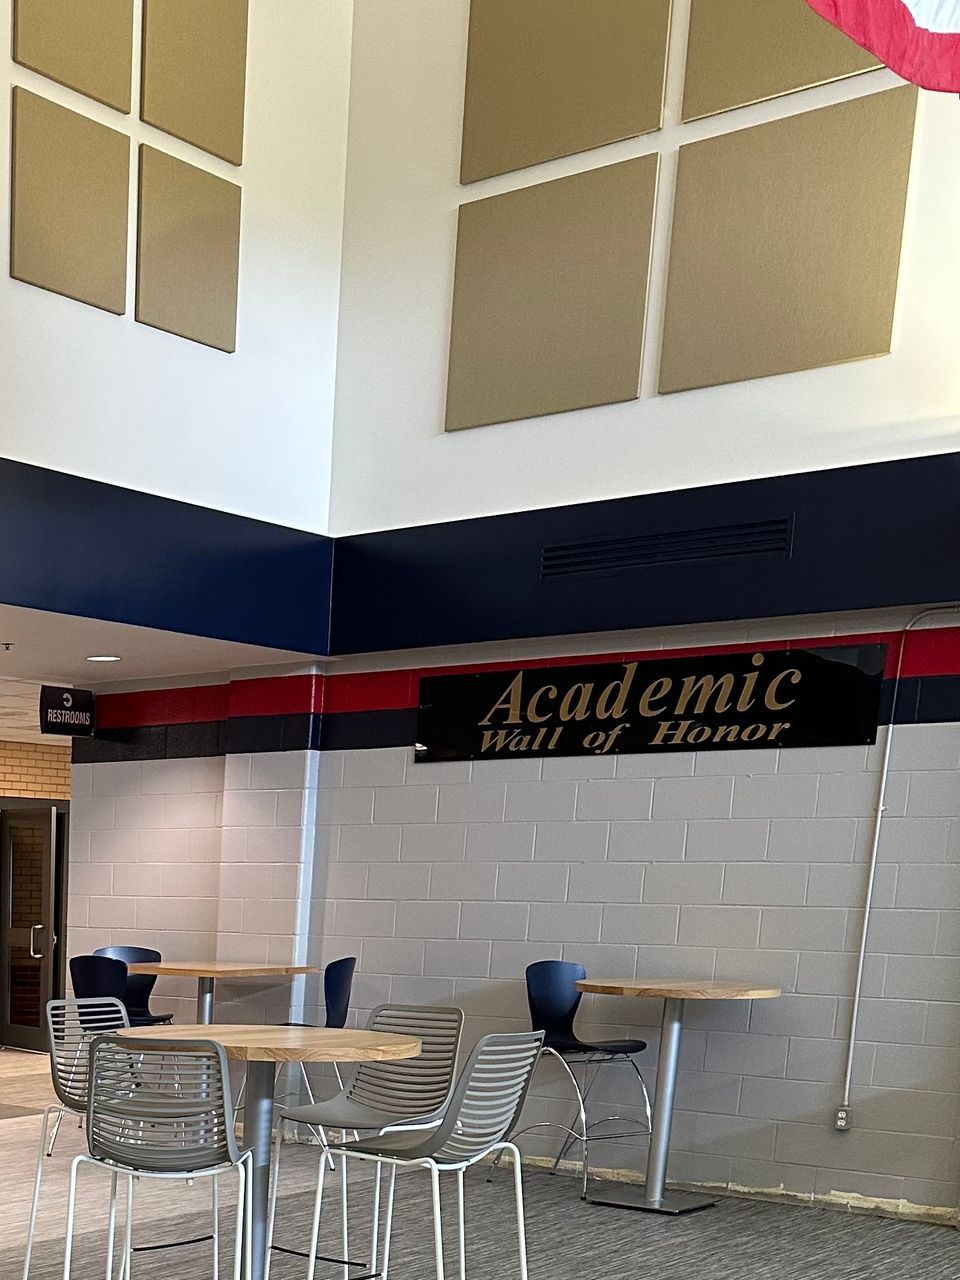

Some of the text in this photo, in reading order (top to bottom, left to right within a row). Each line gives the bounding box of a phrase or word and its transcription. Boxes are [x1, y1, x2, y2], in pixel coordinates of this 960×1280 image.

[478, 652, 802, 726] Academic
[47, 709, 91, 725] RESTROOMS
[481, 719, 791, 754] Wall of Honor
